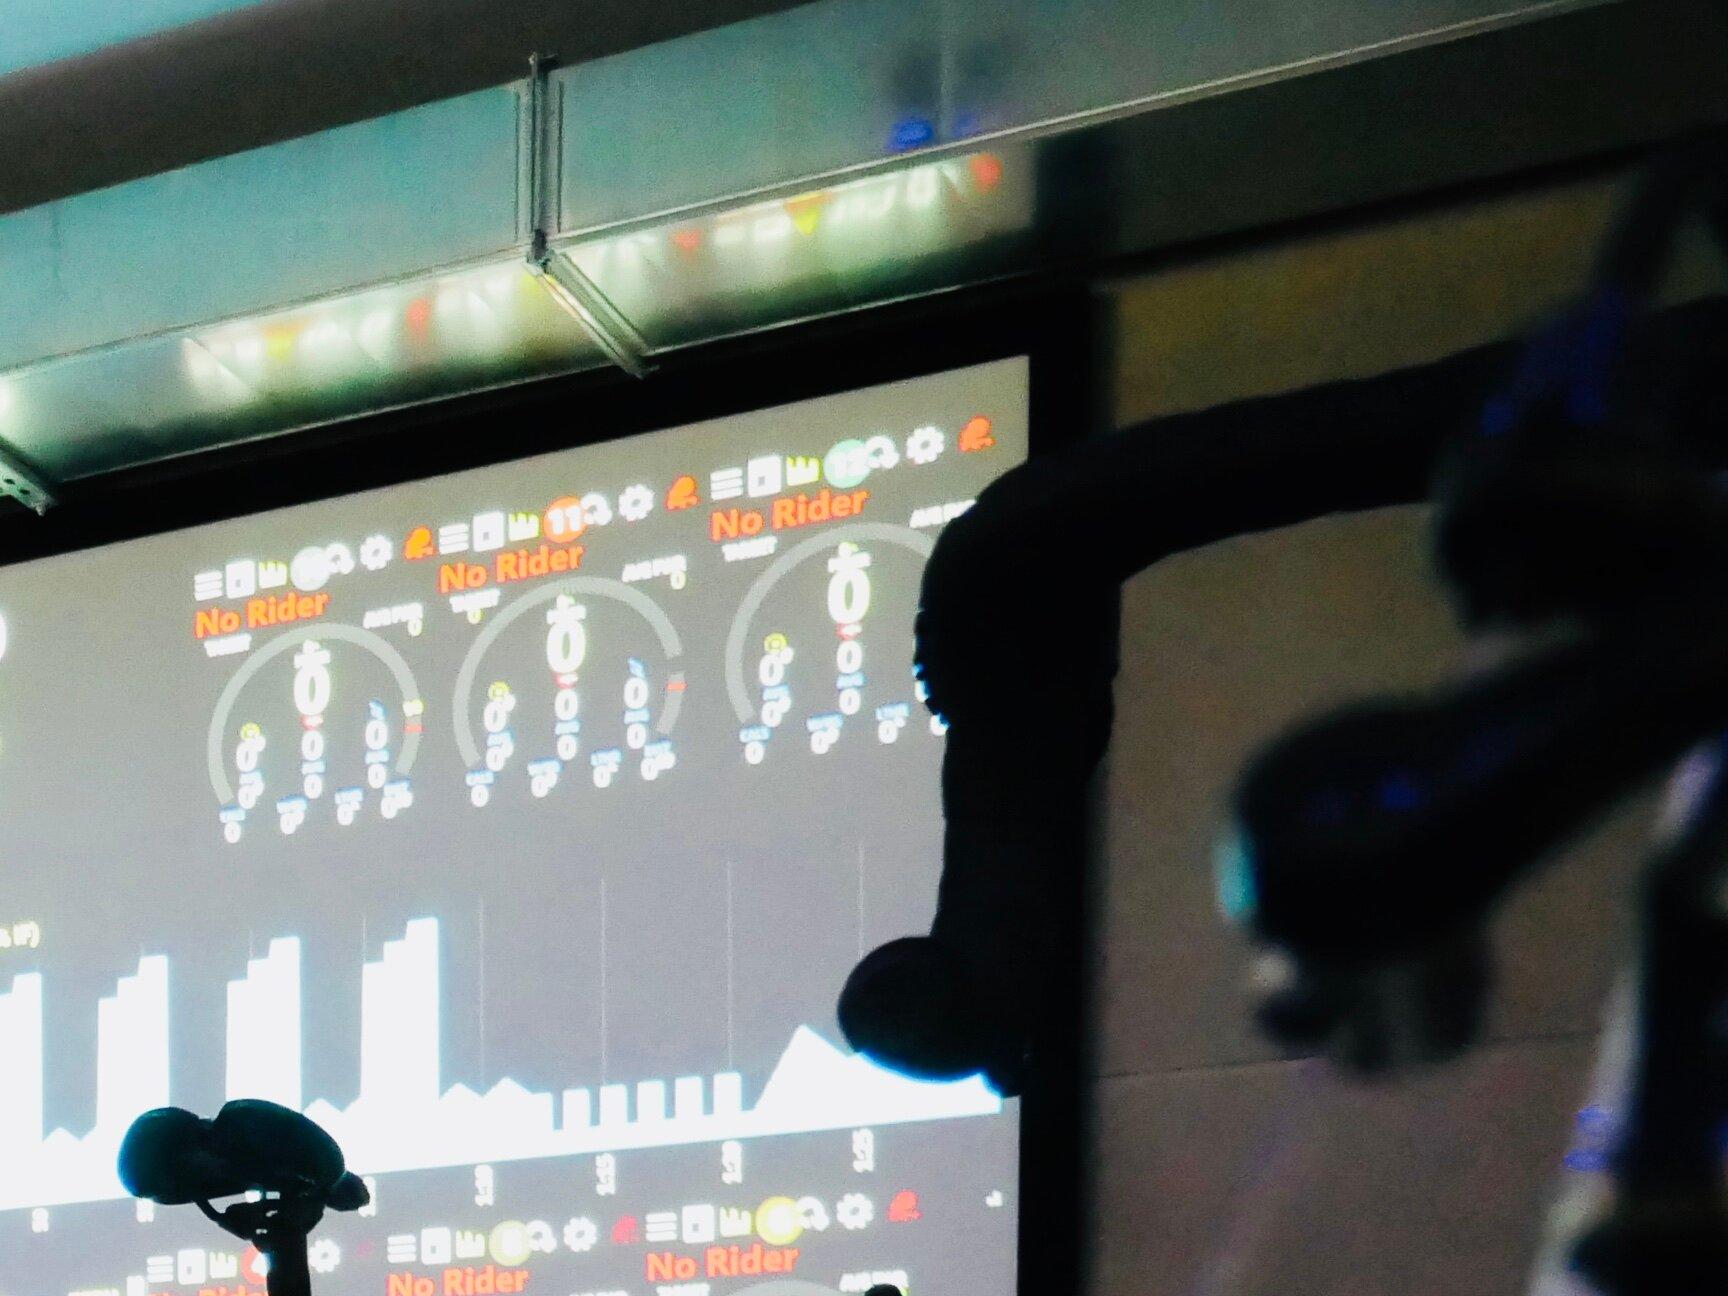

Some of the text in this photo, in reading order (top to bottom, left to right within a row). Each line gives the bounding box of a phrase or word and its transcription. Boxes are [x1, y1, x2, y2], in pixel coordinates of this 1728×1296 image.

[547, 505, 584, 535] 11
[710, 489, 871, 542] No Rider
[436, 544, 587, 594] No Rider
[193, 591, 331, 639] No Rider
[646, 1243, 800, 1282] No Rider
